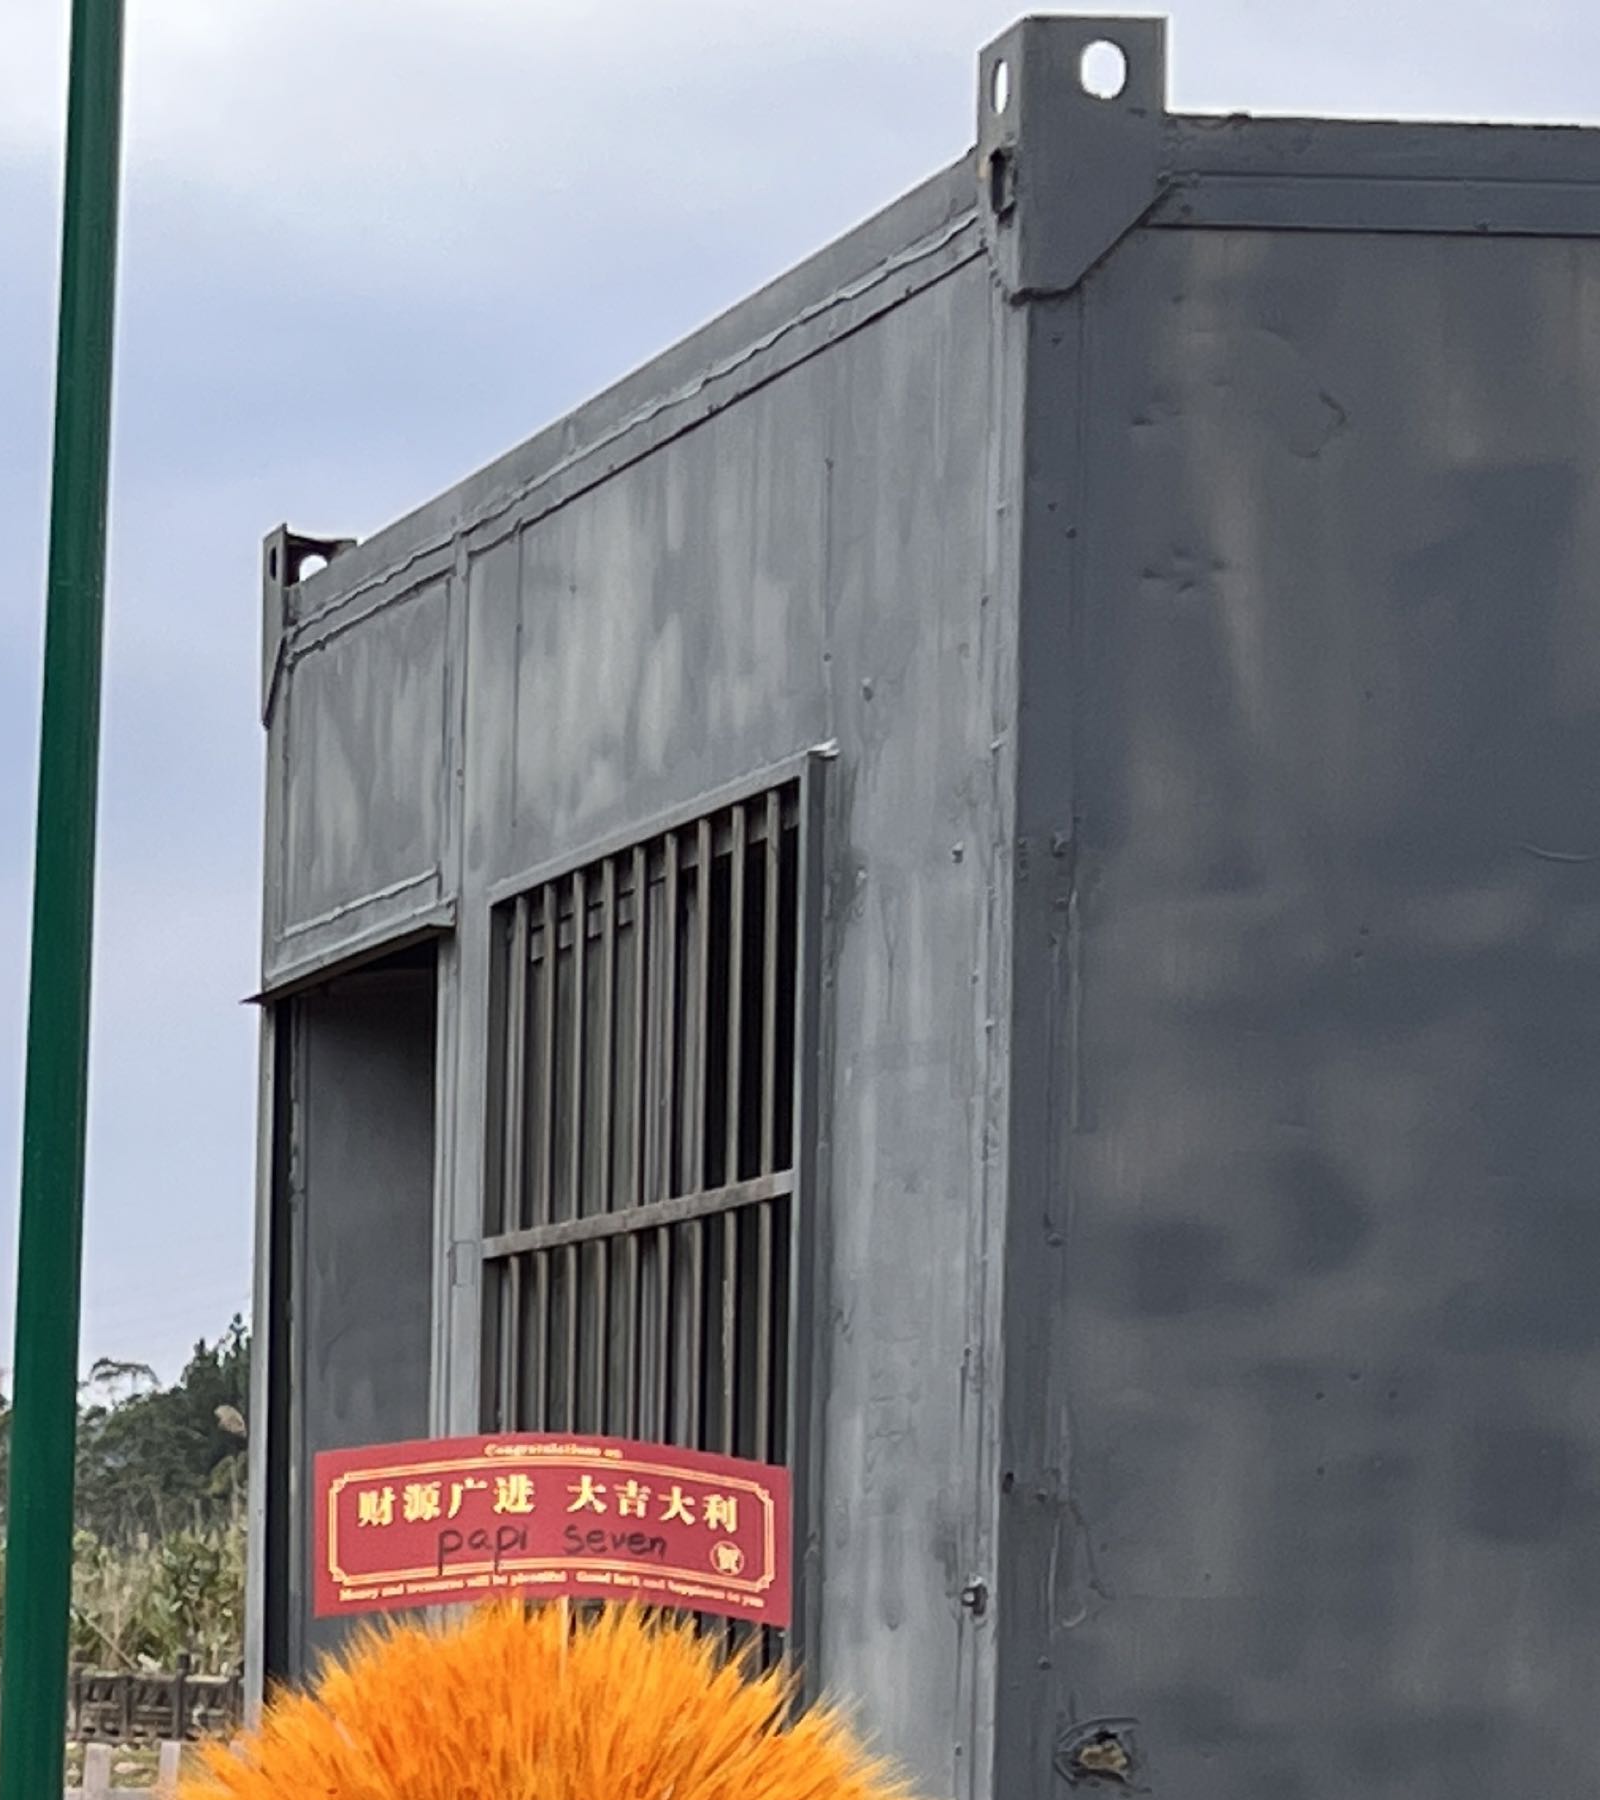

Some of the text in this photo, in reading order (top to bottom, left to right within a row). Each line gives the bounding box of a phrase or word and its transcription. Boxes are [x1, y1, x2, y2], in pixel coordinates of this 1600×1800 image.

[357, 1474, 739, 1534] 财源广进 大吉大利
